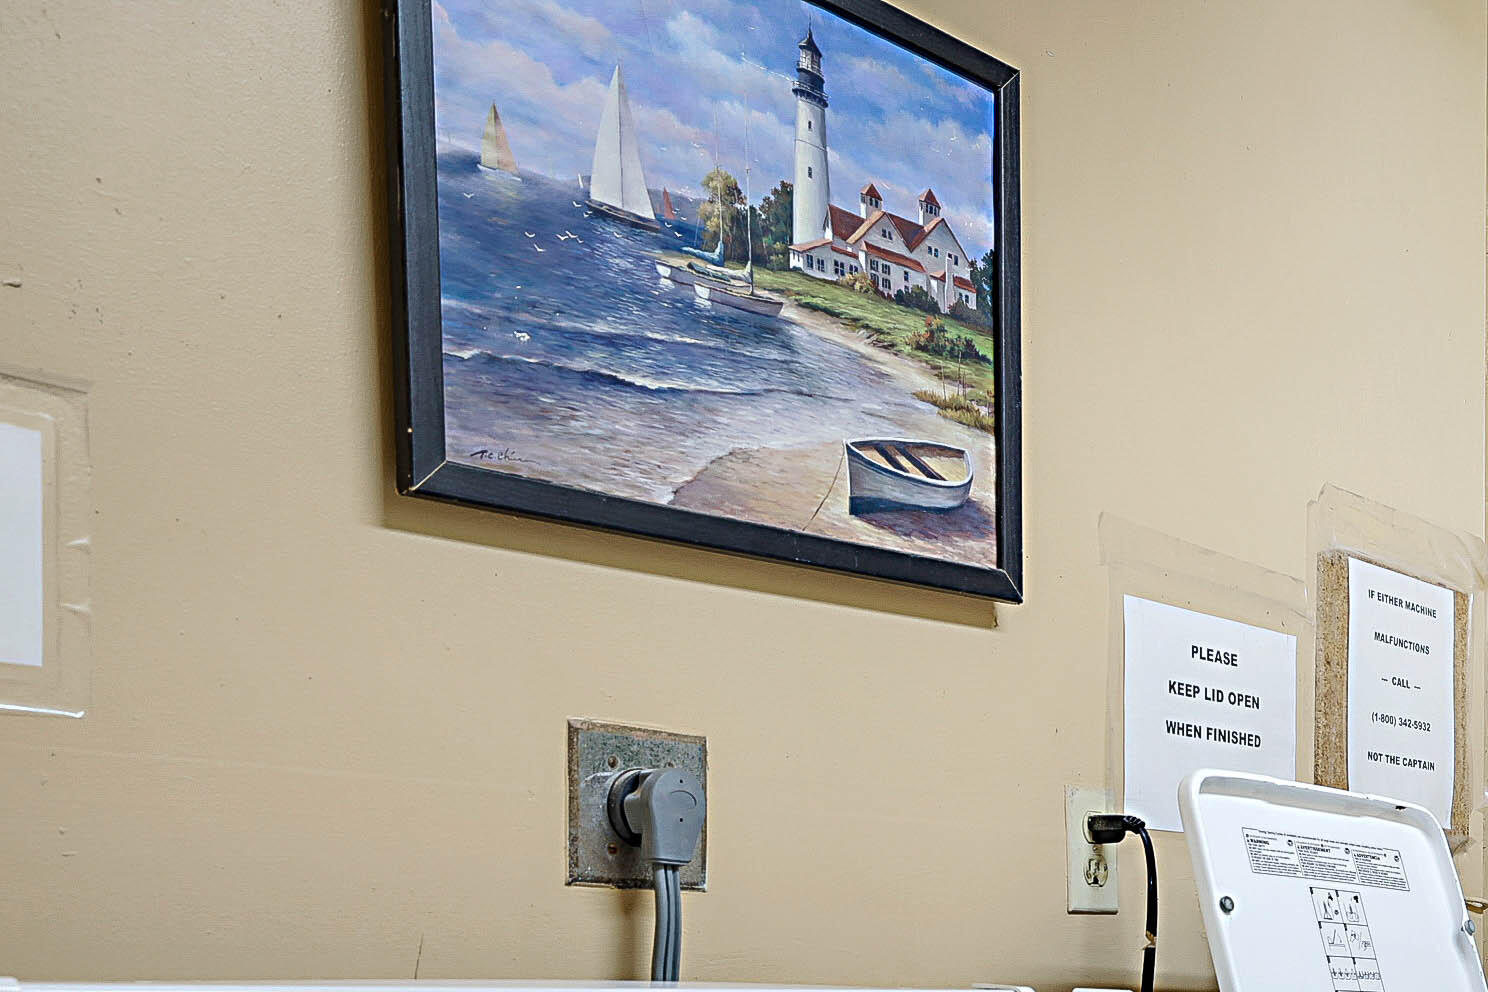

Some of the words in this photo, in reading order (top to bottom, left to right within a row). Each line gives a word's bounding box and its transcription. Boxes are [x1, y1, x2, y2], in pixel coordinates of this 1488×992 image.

[1368, 589, 1376, 600] IF
[1377, 592, 1404, 609] EITHER
[1405, 600, 1437, 618] MACHINE
[1374, 631, 1430, 655] MALFUNCTIONS
[1191, 645, 1238, 667] PLEASE
[1391, 676, 1411, 689] CALL
[1168, 680, 1200, 698] KEEP
[1204, 687, 1224, 703] LID
[1228, 692, 1260, 709] OPEN
[1371, 712, 1397, 728] (1-800)
[1398, 717, 1431, 732] 342-5932
[1166, 720, 1202, 739] WHEN
[1206, 727, 1261, 748] FINISHED
[1367, 751, 1384, 763] NOT
[1385, 754, 1400, 766] THE
[1402, 757, 1435, 771] CAPTAIN
